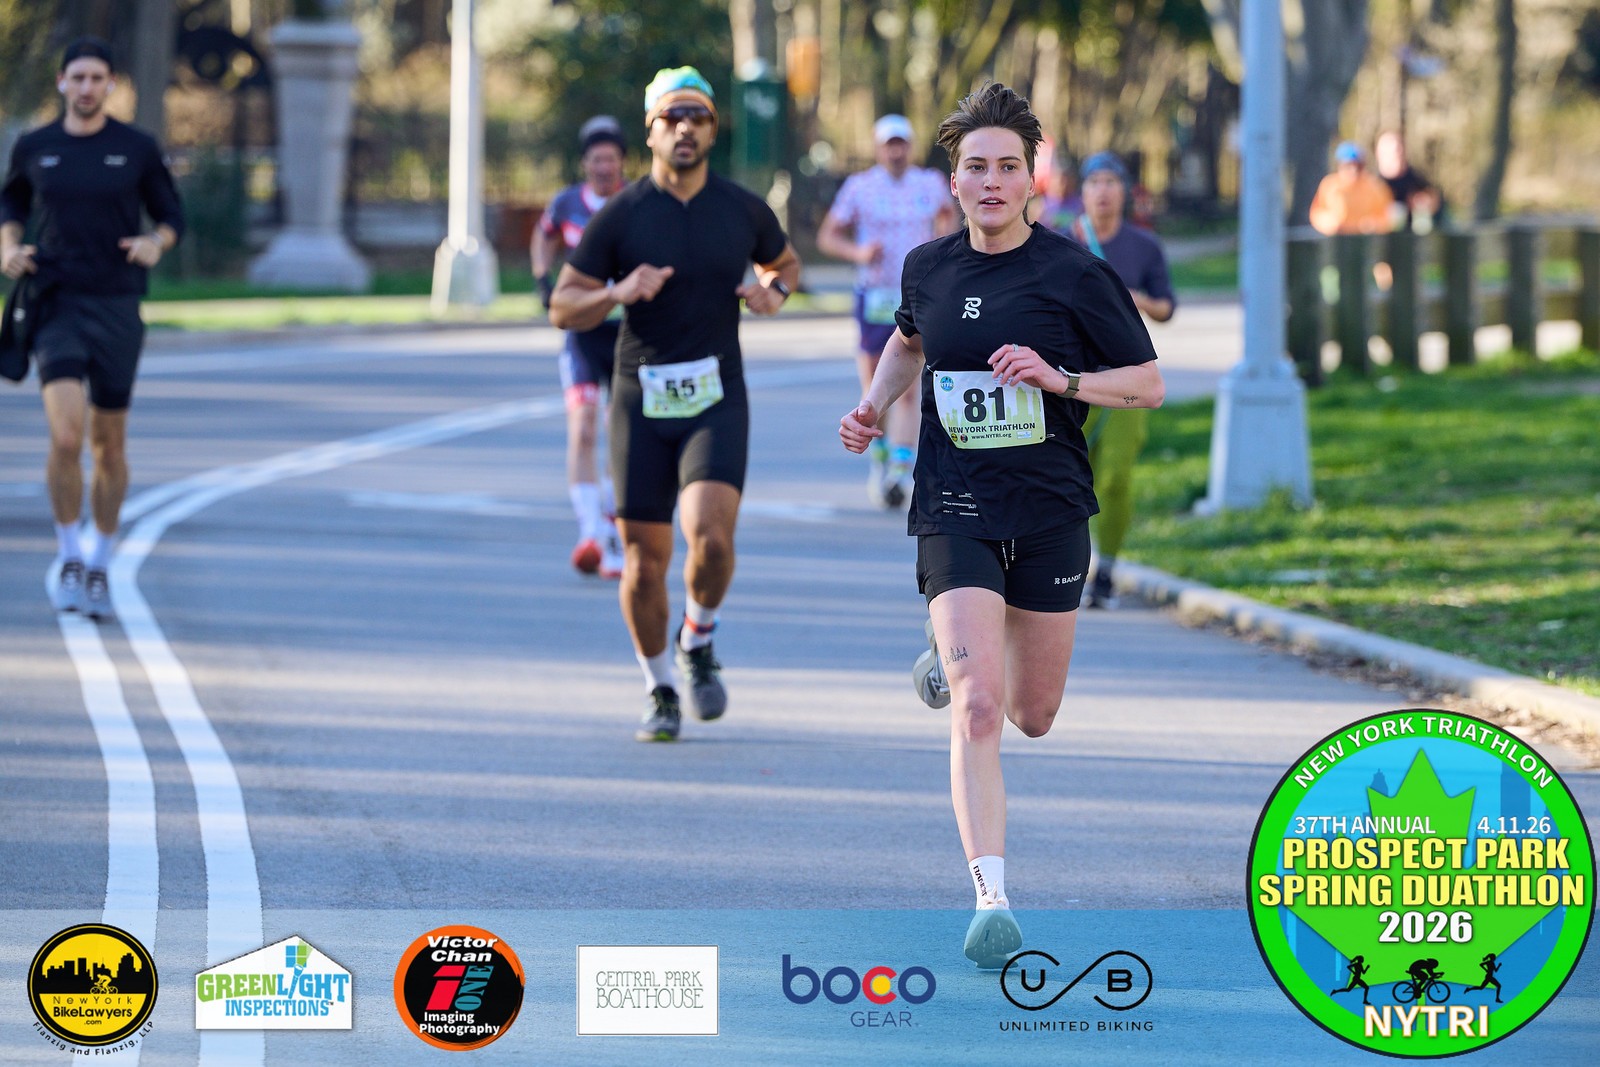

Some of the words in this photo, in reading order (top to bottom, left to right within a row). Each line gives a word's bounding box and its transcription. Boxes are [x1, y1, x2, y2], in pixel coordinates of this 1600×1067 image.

[665, 378, 695, 399] 55
[963, 387, 1006, 423] 81
[948, 426, 964, 434] NEW
[964, 425, 987, 433] YORK
[988, 422, 1036, 432] TRIATHLON
[971, 432, 1012, 440] www.NYTRI.org
